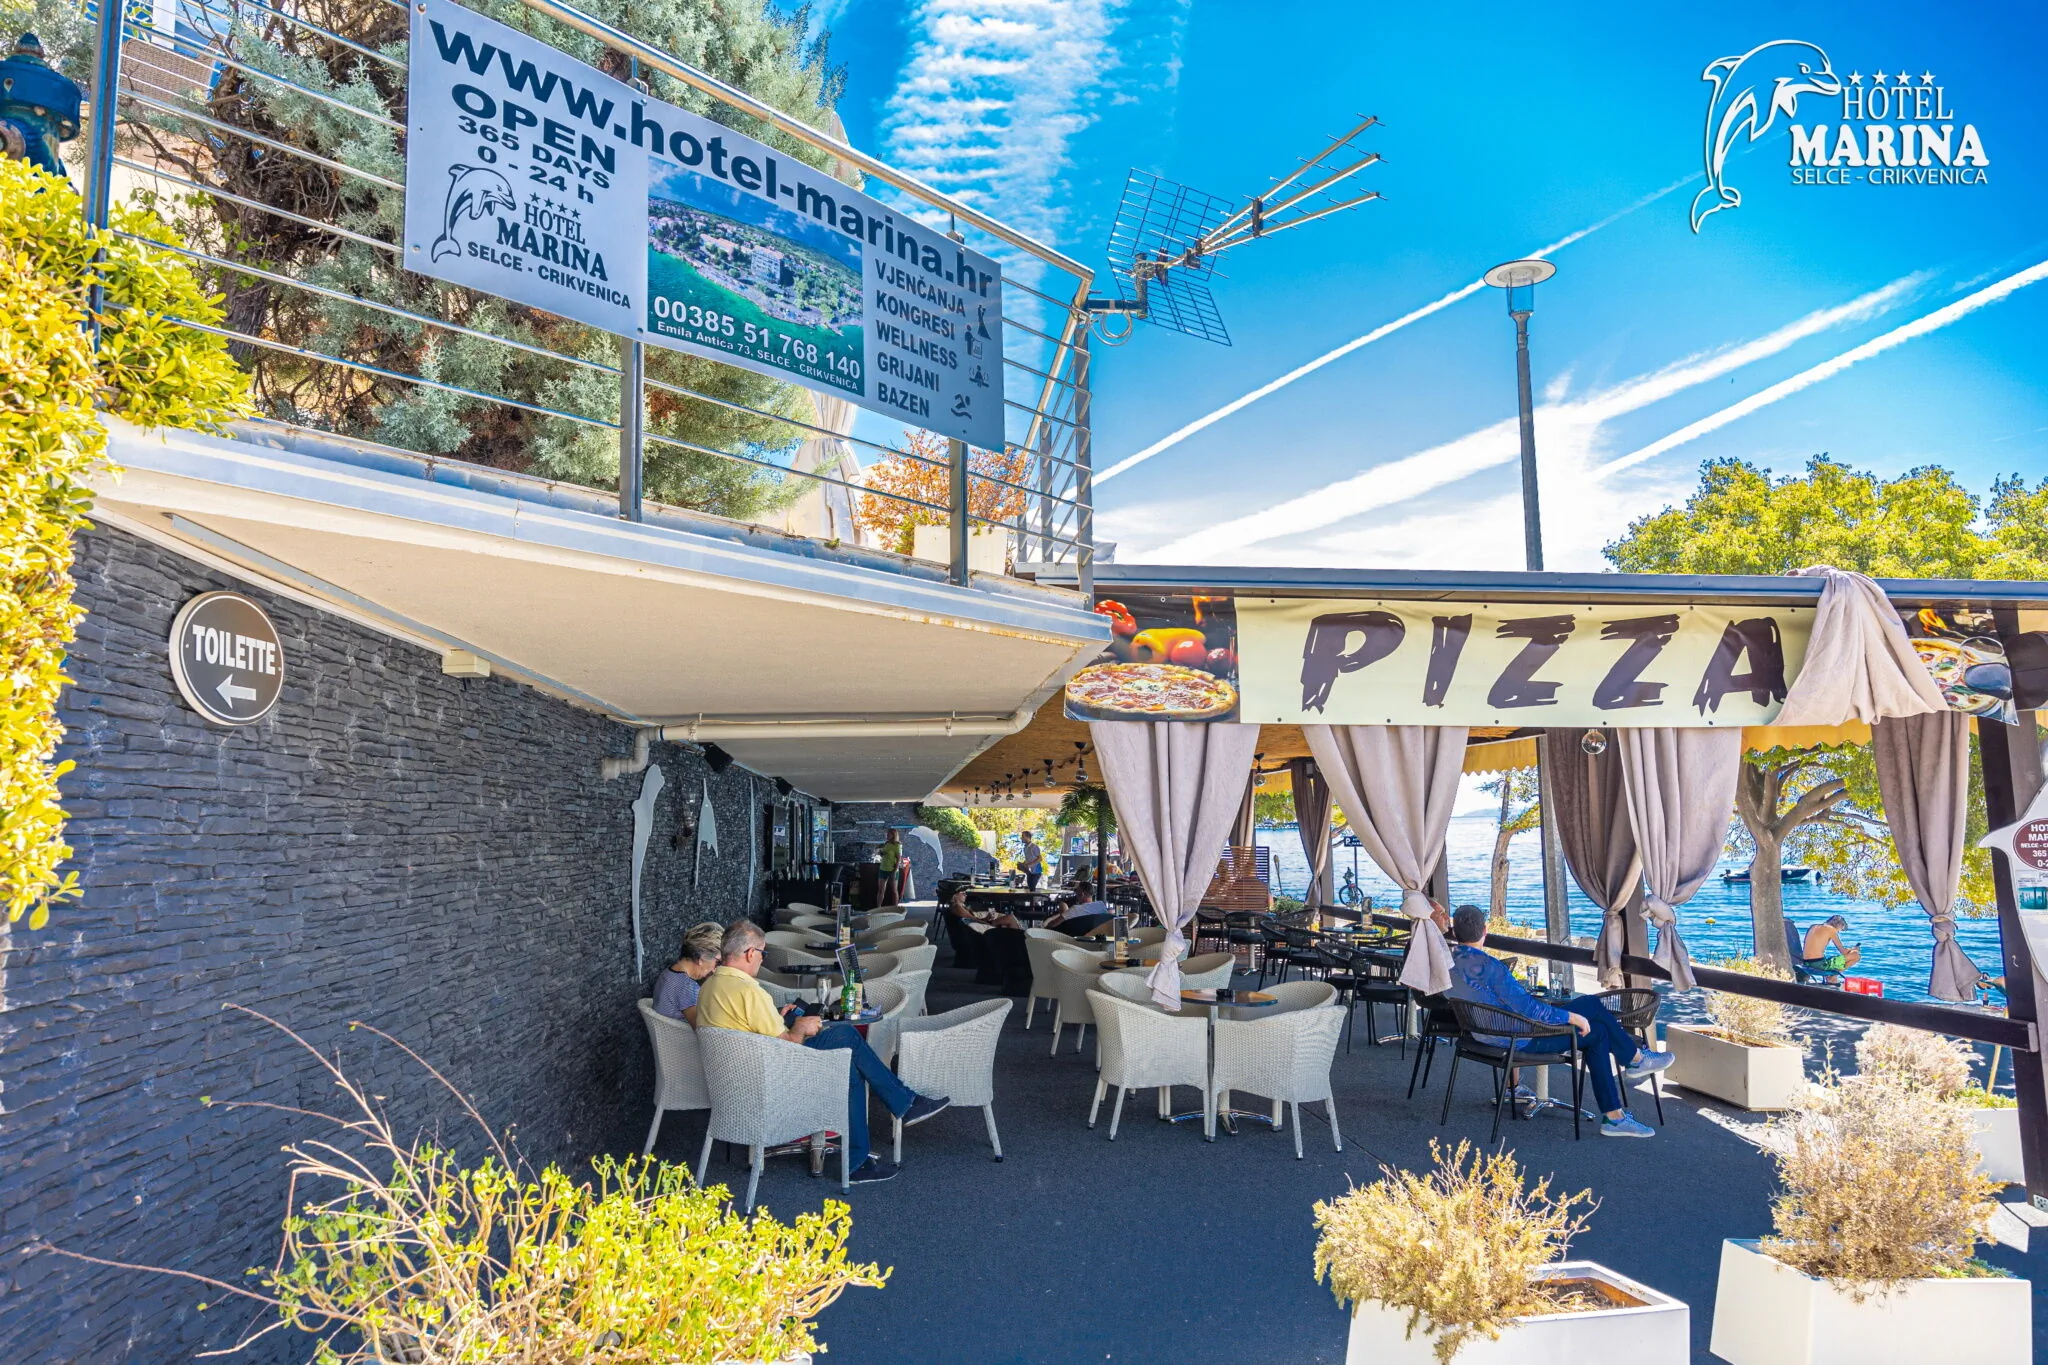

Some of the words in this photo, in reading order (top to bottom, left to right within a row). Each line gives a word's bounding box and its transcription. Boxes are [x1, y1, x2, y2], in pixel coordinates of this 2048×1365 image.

[428, 19, 993, 299] www.hotel-marina.hr
[451, 84, 616, 174] OPEN
[458, 116, 519, 151] 365
[532, 144, 610, 189] DAYS
[477, 146, 497, 164] 0
[529, 165, 567, 192] 24
[578, 185, 594, 204] h
[496, 217, 608, 282] MARINA
[524, 202, 586, 245] HOTEL
[467, 242, 523, 272] SELCE
[537, 266, 631, 309] CRIKVENICA
[875, 259, 966, 317] VJENČANJA
[653, 296, 735, 337] 00385
[743, 322, 769, 348] 51
[779, 334, 818, 364] 768
[826, 351, 861, 380] 140
[876, 290, 955, 341] KONGRESI
[876, 320, 957, 370] WELLNESS
[657, 321, 692, 338] Emila
[696, 333, 734, 350] Antica
[757, 350, 791, 368] SELCE
[799, 363, 858, 391] CRIKVENICA
[877, 352, 940, 392] GRIJANI
[878, 382, 930, 418] BAZEN
[192, 624, 276, 676] TOILETTE
[1300, 610, 1788, 716] PIZZA
